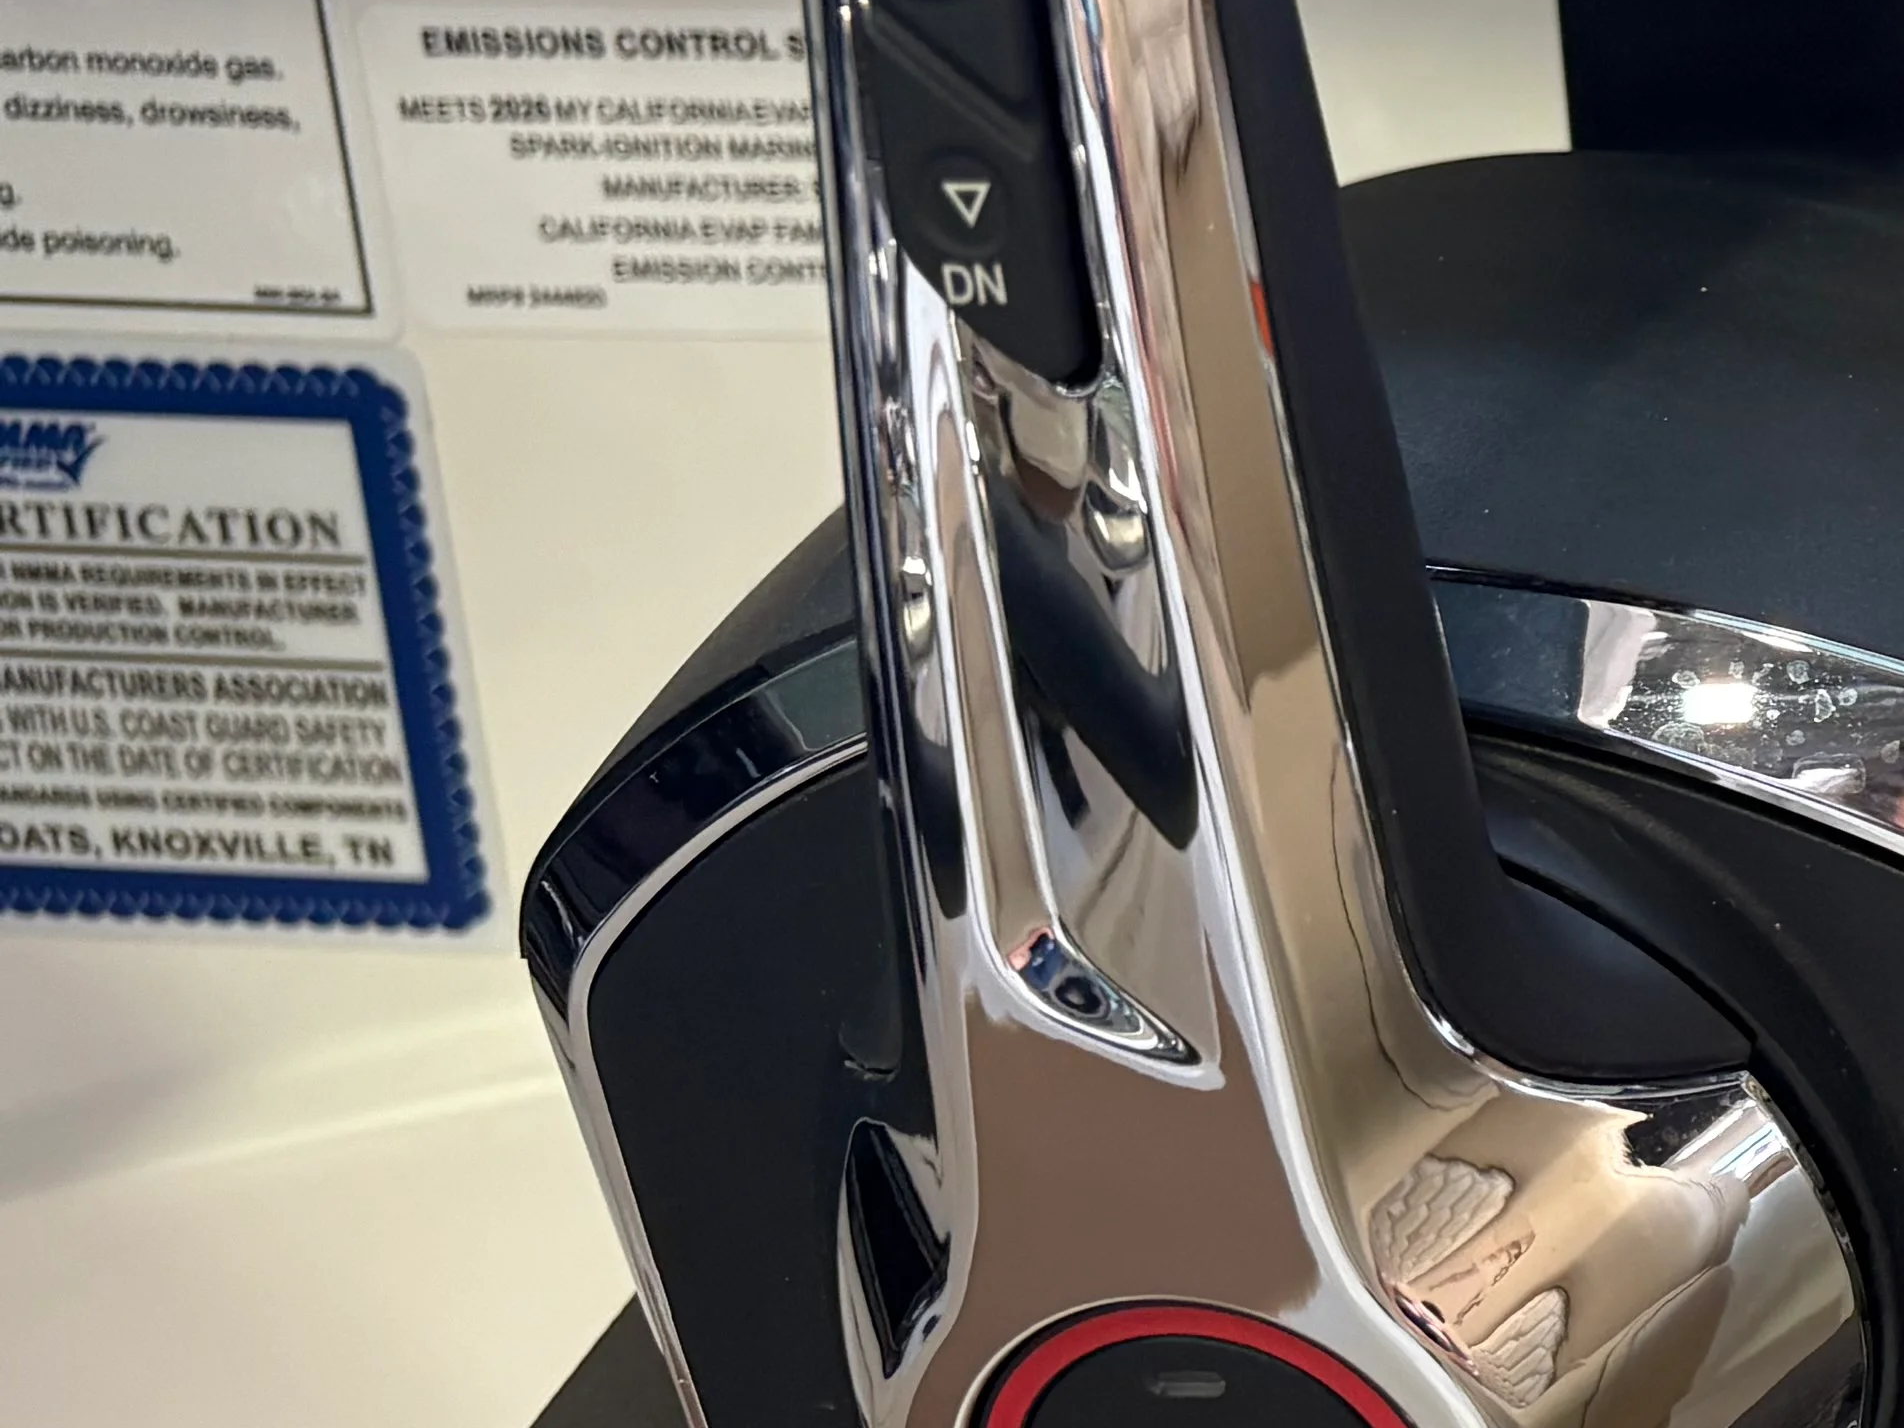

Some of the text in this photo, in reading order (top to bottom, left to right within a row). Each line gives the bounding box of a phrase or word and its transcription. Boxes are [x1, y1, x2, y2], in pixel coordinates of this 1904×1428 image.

[421, 27, 607, 59] EMISSIONS
[614, 28, 780, 61] CONTROL
[0, 45, 284, 85] arbon monoxide gas.
[4, 93, 301, 132] dizziness, drowsiness,
[398, 95, 487, 123] MEETS
[554, 96, 592, 123] MY
[597, 97, 751, 126] CALIFORNIA
[43, 228, 181, 263] poisoning.
[539, 215, 698, 244] CALIFORNIA
[611, 255, 742, 284] EMISSION
[942, 263, 1008, 306] DN
[0, 500, 341, 548] RTIFICATION
[2, 664, 390, 710] ANUFACTURERS ASSOCIATION
[6, 705, 68, 735] WITH
[119, 708, 199, 744] COAST
[0, 824, 395, 869] OATS, KNOXVILLE, TN
